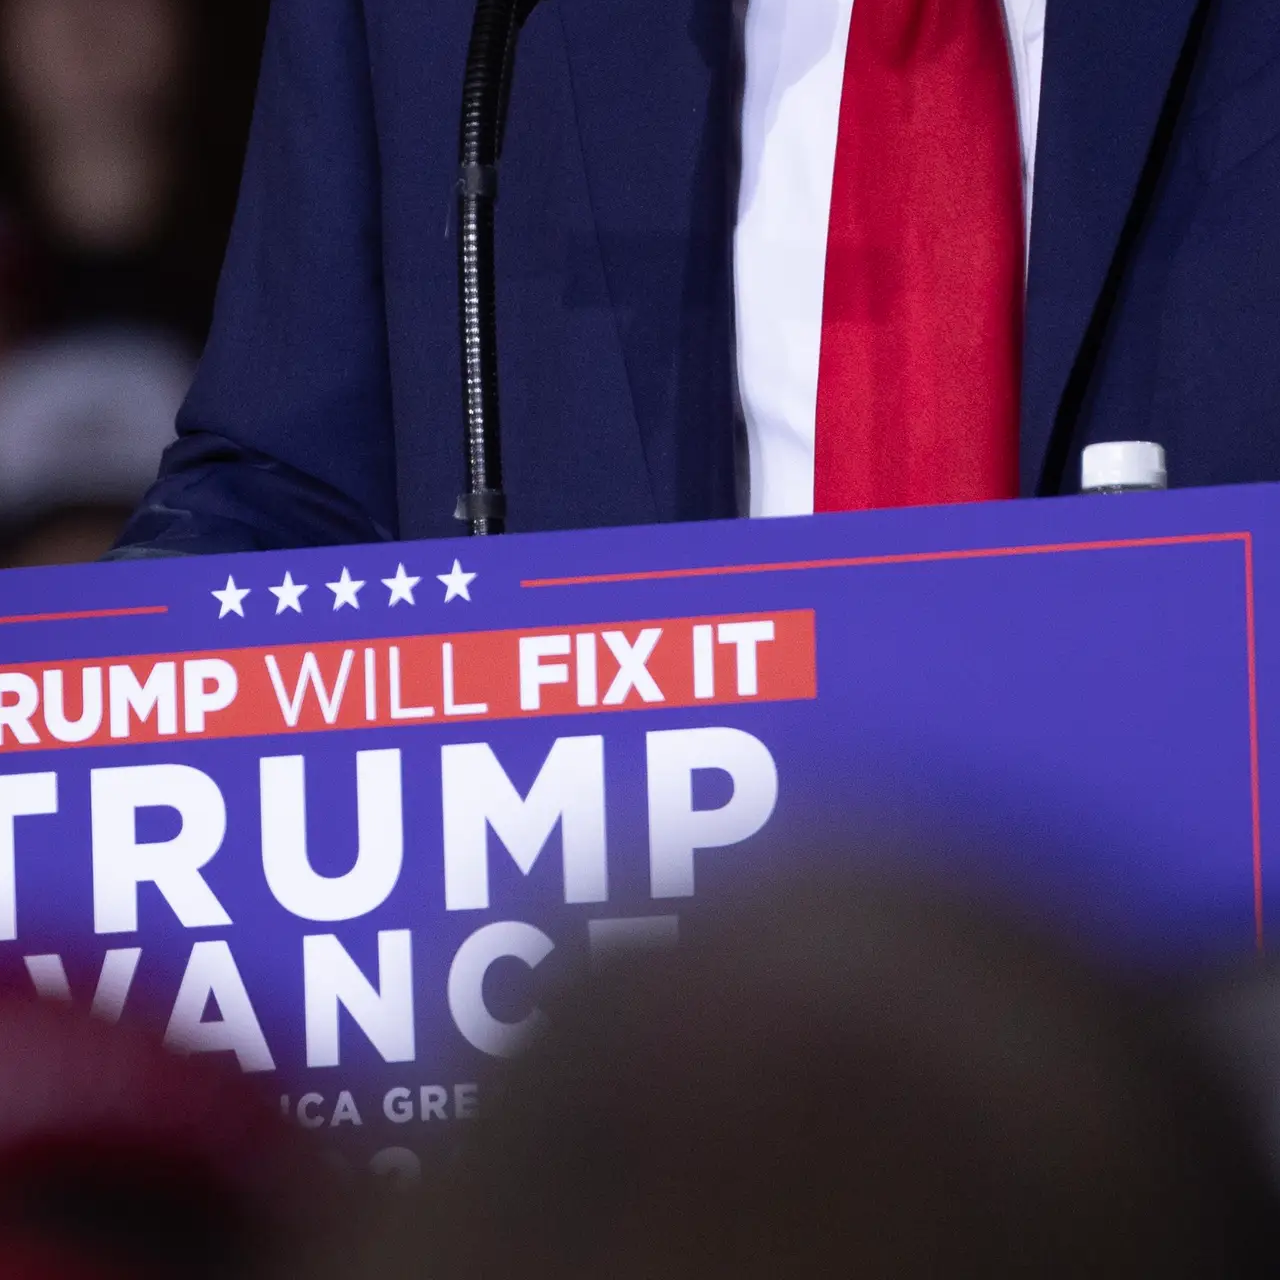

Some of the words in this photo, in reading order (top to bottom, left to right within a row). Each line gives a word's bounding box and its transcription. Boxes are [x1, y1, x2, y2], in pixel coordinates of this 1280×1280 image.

[264, 641, 488, 726] WILL
[519, 628, 665, 711] FIX
[693, 620, 775, 698] IT
[24, 915, 680, 1072] VANC
[382, 1083, 478, 1123] GRE
